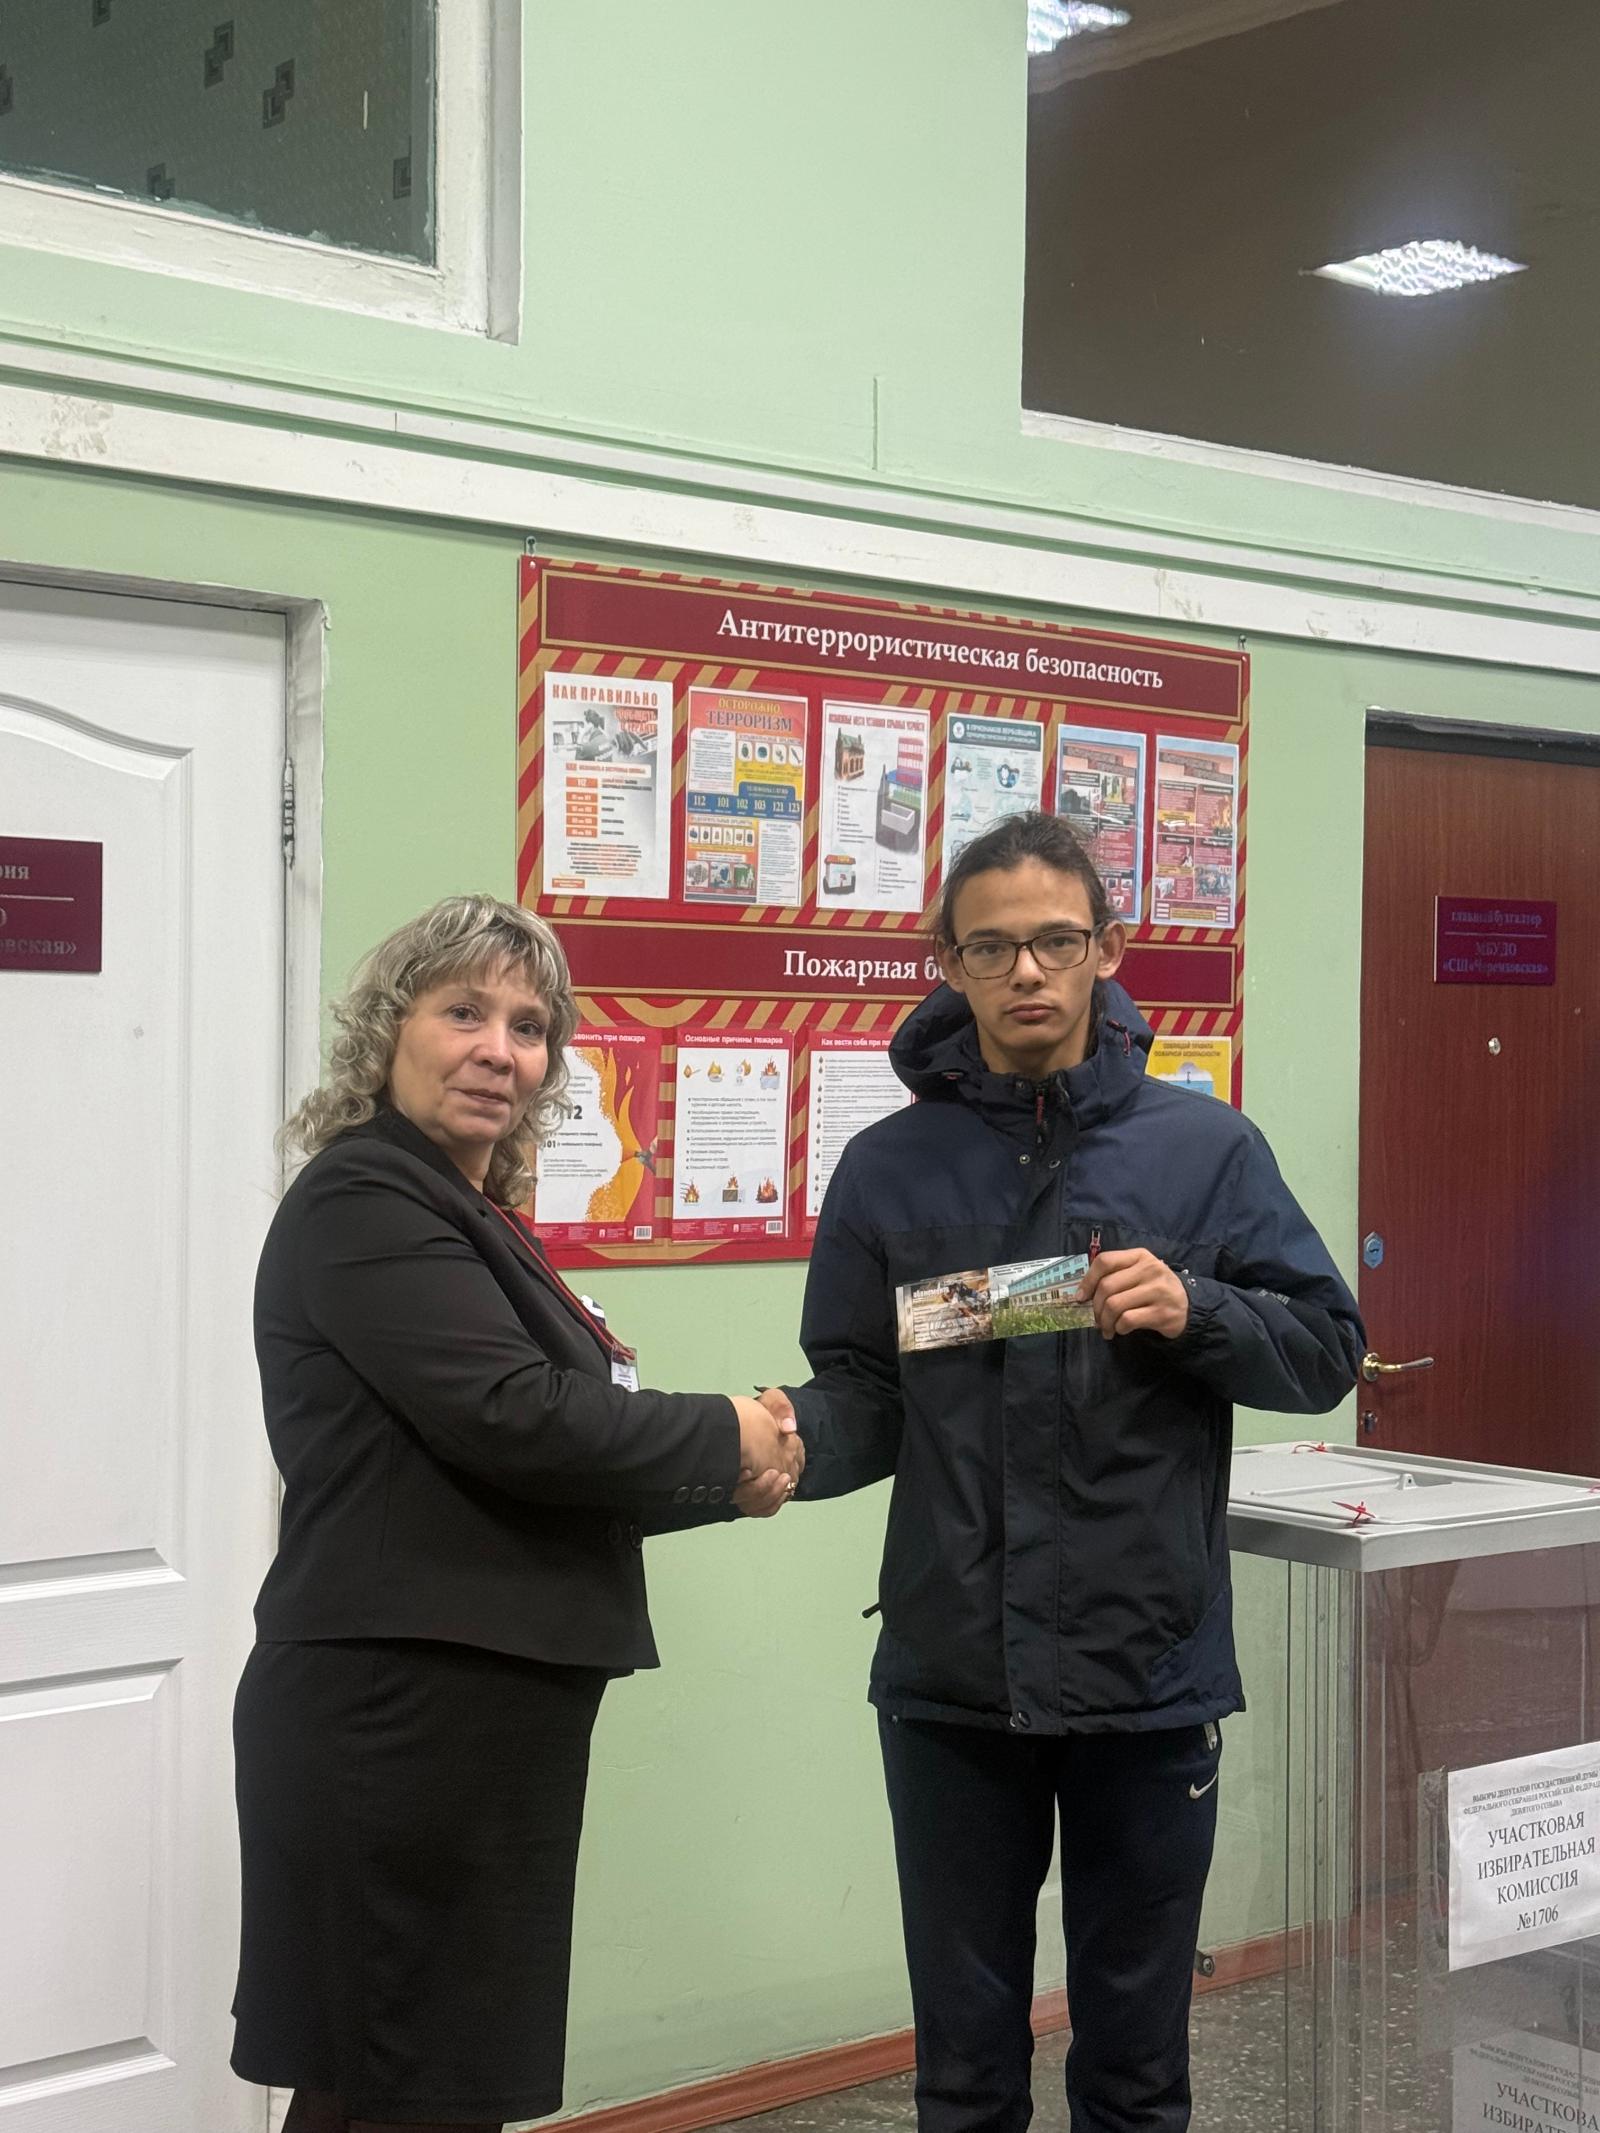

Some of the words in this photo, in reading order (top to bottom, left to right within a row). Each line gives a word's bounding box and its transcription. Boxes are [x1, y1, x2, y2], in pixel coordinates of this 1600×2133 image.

[716, 609, 1020, 670] Антитеррористическая
[1025, 648, 1163, 689] безопасность
[580, 686, 658, 707] ПРАВИЛЬНО
[706, 711, 793, 732] ТЕРРОРИЗМ
[693, 795, 706, 806] 112
[717, 797, 730, 808] 101
[736, 798, 748, 809] 102
[754, 800, 766, 810] 103
[0, 864, 30, 880] ия
[783, 949, 919, 987] Пожарная
[567, 1104, 583, 1120] 12
[1463, 1800, 1508, 1815] ФЕДЕРАЛЬНОГО
[1508, 1794, 1538, 1806] СОБРАНИЯ
[1538, 1786, 1574, 1801] РОССИЙСКОЙ
[1575, 1781, 1600, 1793] ФЕДЕРАЦ
[1497, 1786, 1531, 1798] ДЕПУТАТОВ
[1487, 1811, 1585, 1848] УЧАСТКОВАЯ
[1478, 1836, 1596, 1880] ИЗБИРАТЕЛЬНАЯ
[1497, 1868, 1579, 1905] КОМИССИЯ
[1516, 1904, 1559, 1931] №1706
[1496, 2081, 1600, 2132] УЧАСТКОВА
